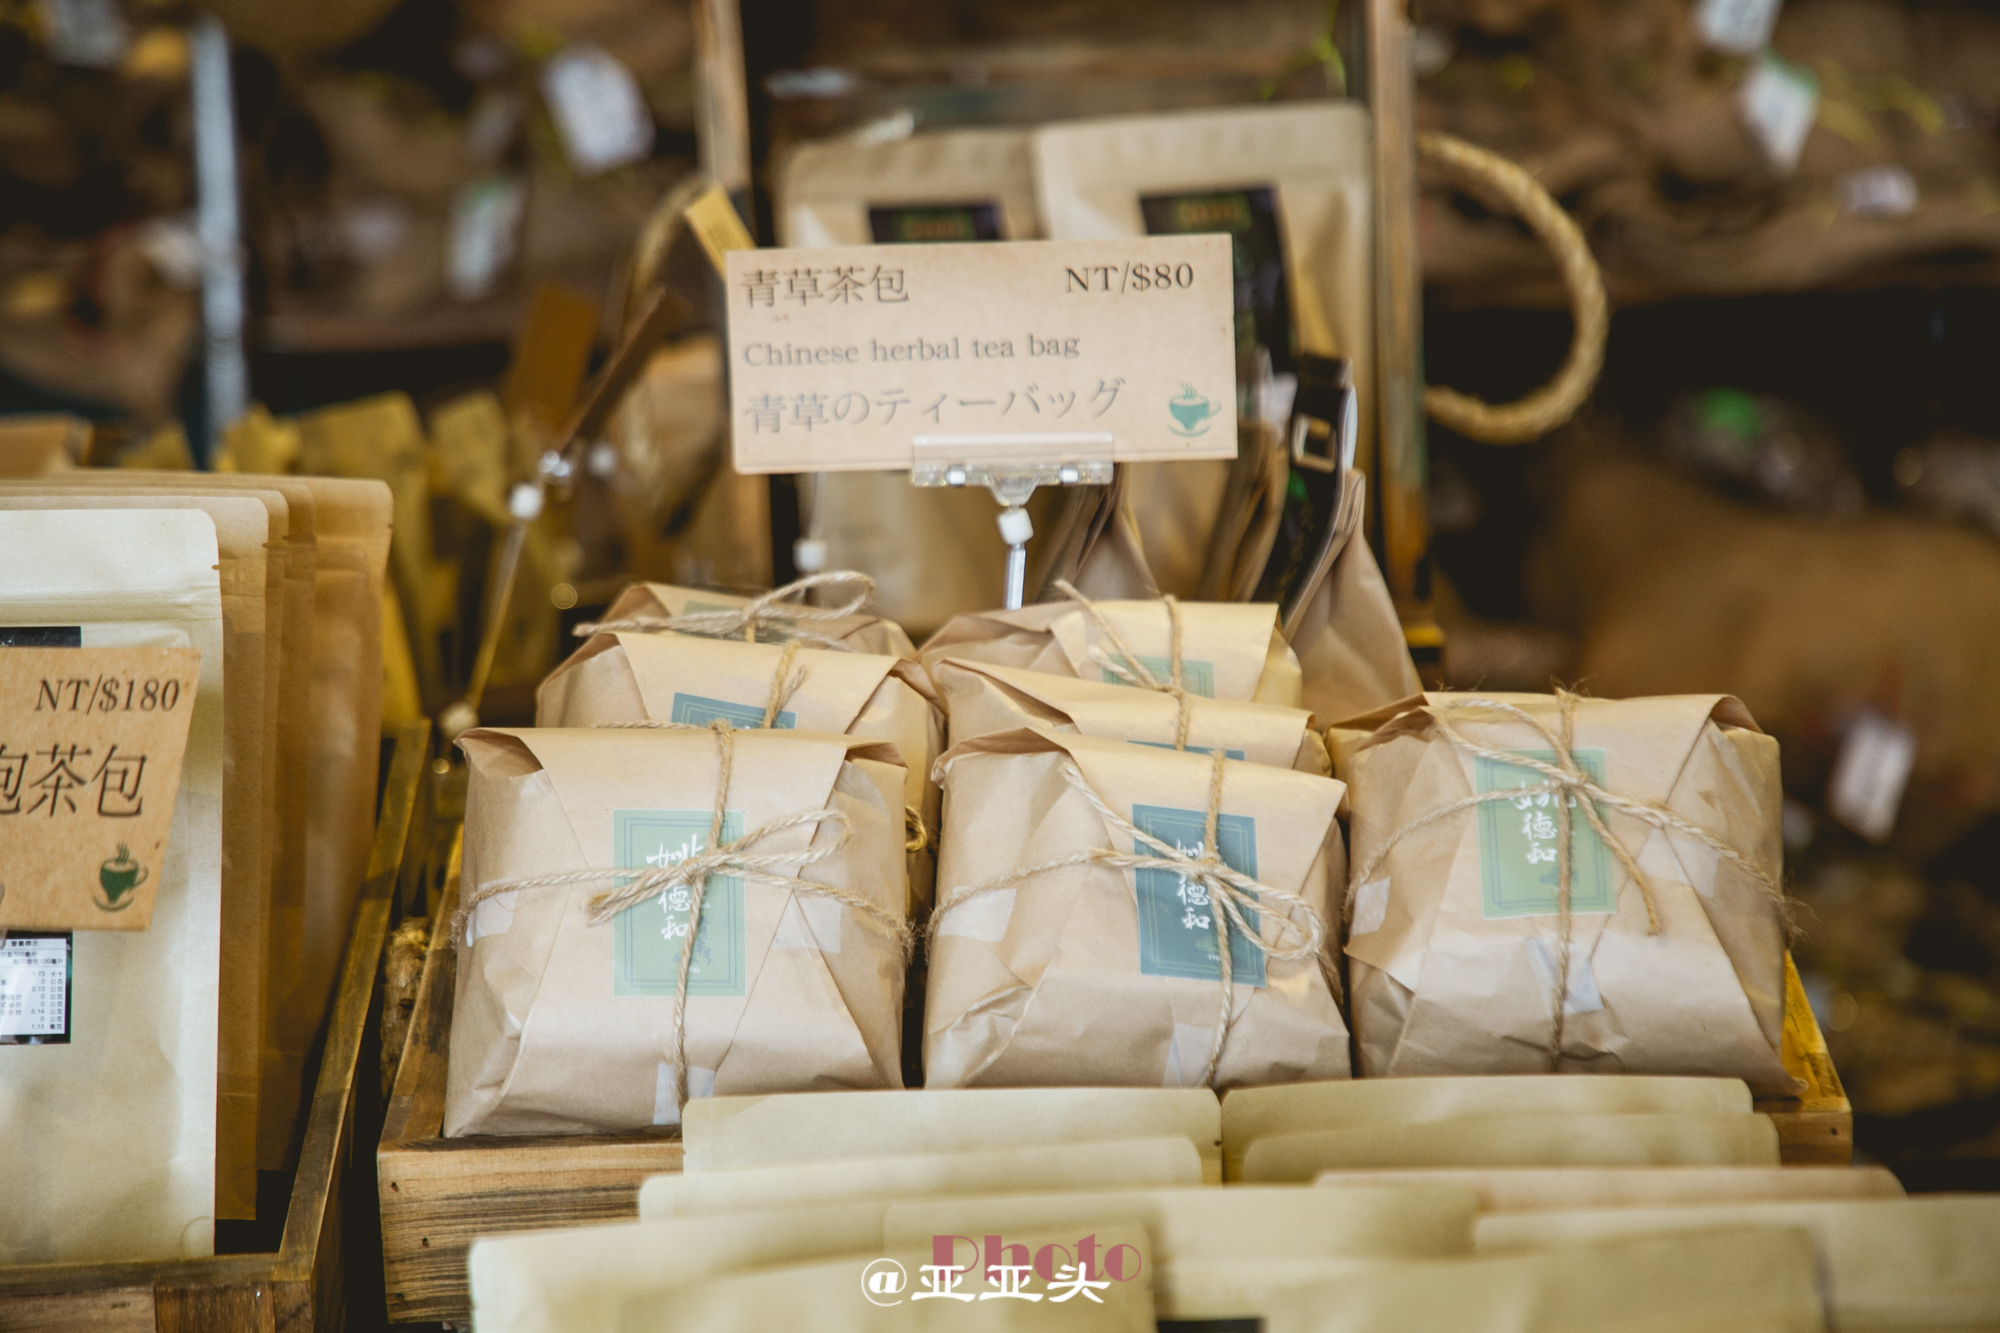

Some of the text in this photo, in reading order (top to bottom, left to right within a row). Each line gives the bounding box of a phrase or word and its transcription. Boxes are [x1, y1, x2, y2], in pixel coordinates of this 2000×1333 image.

[741, 265, 911, 309] 青草茶包
[1065, 262, 1195, 294] NT/$80
[744, 334, 1080, 367] Chinese herbal tea bag
[744, 376, 1127, 434] 青草のティーバッグ
[35, 674, 180, 715] NT/$180
